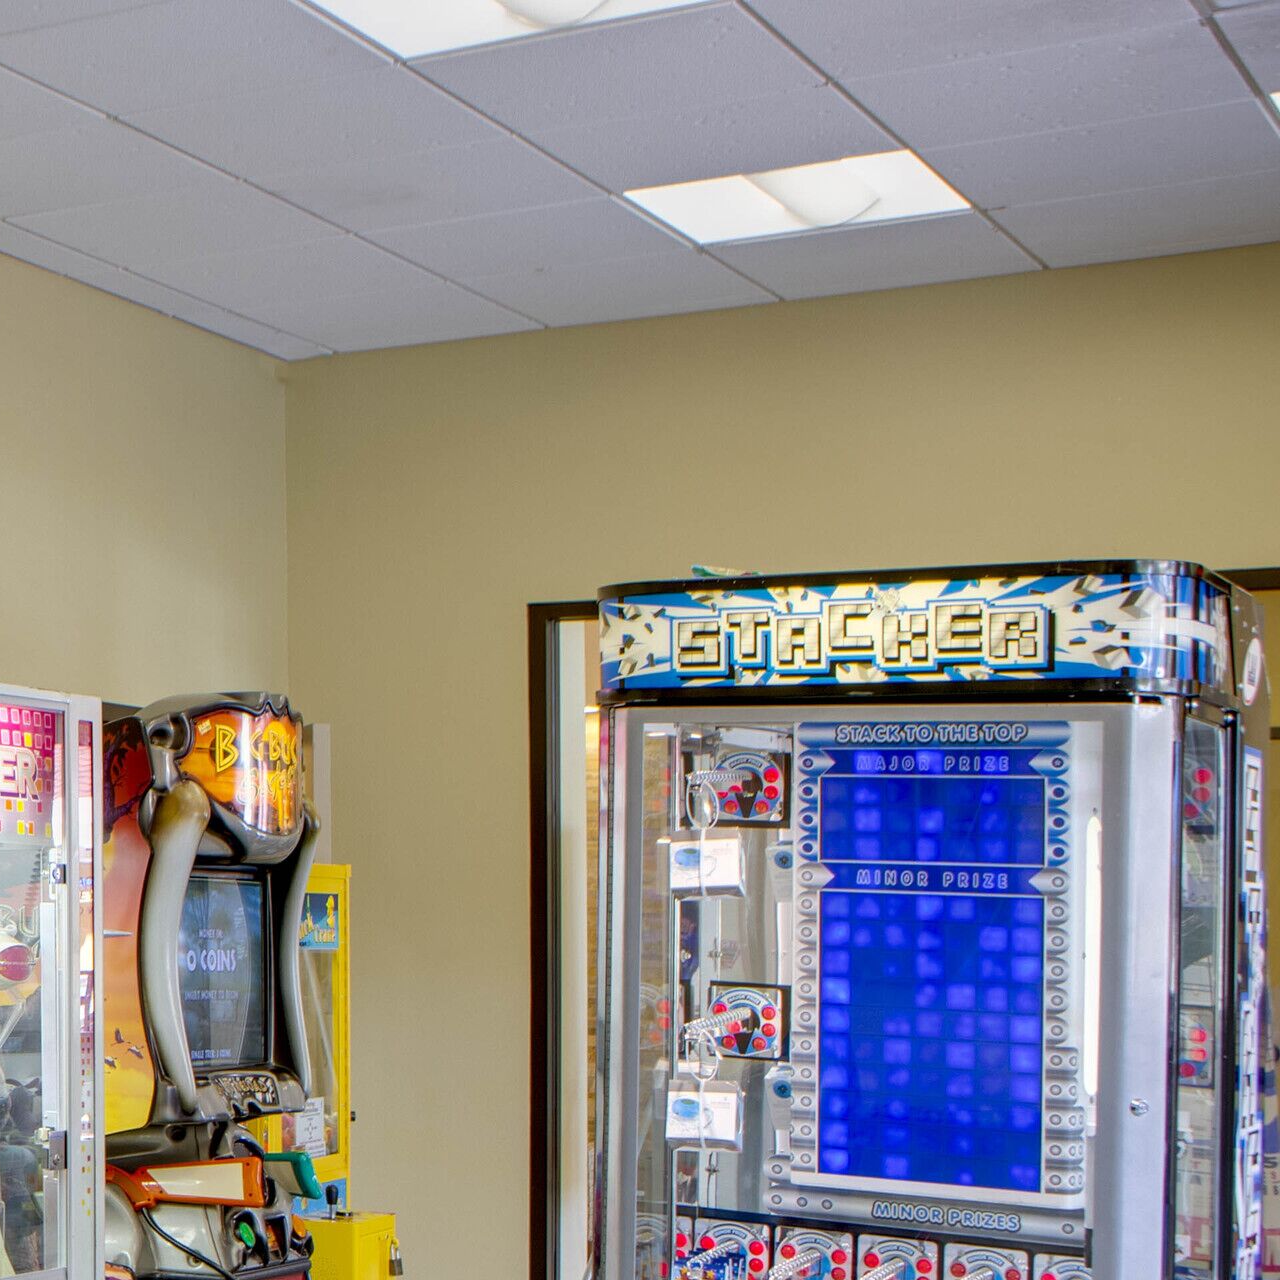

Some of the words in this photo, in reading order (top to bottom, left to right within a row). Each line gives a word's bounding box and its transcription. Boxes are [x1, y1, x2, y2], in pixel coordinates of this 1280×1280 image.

[677, 602, 1037, 668] STACKER
[836, 724, 903, 743] STACK
[905, 724, 930, 741] TO
[933, 723, 977, 742] THE
[981, 722, 1029, 742] TOP
[857, 755, 929, 771] MAJOR
[943, 755, 1010, 771] PRIZE
[856, 870, 928, 888] MINOR
[942, 871, 1009, 889] PRIZE
[201, 950, 236, 972] COINS
[872, 1202, 942, 1223] MINOR
[949, 1210, 1022, 1233] PRIZES
